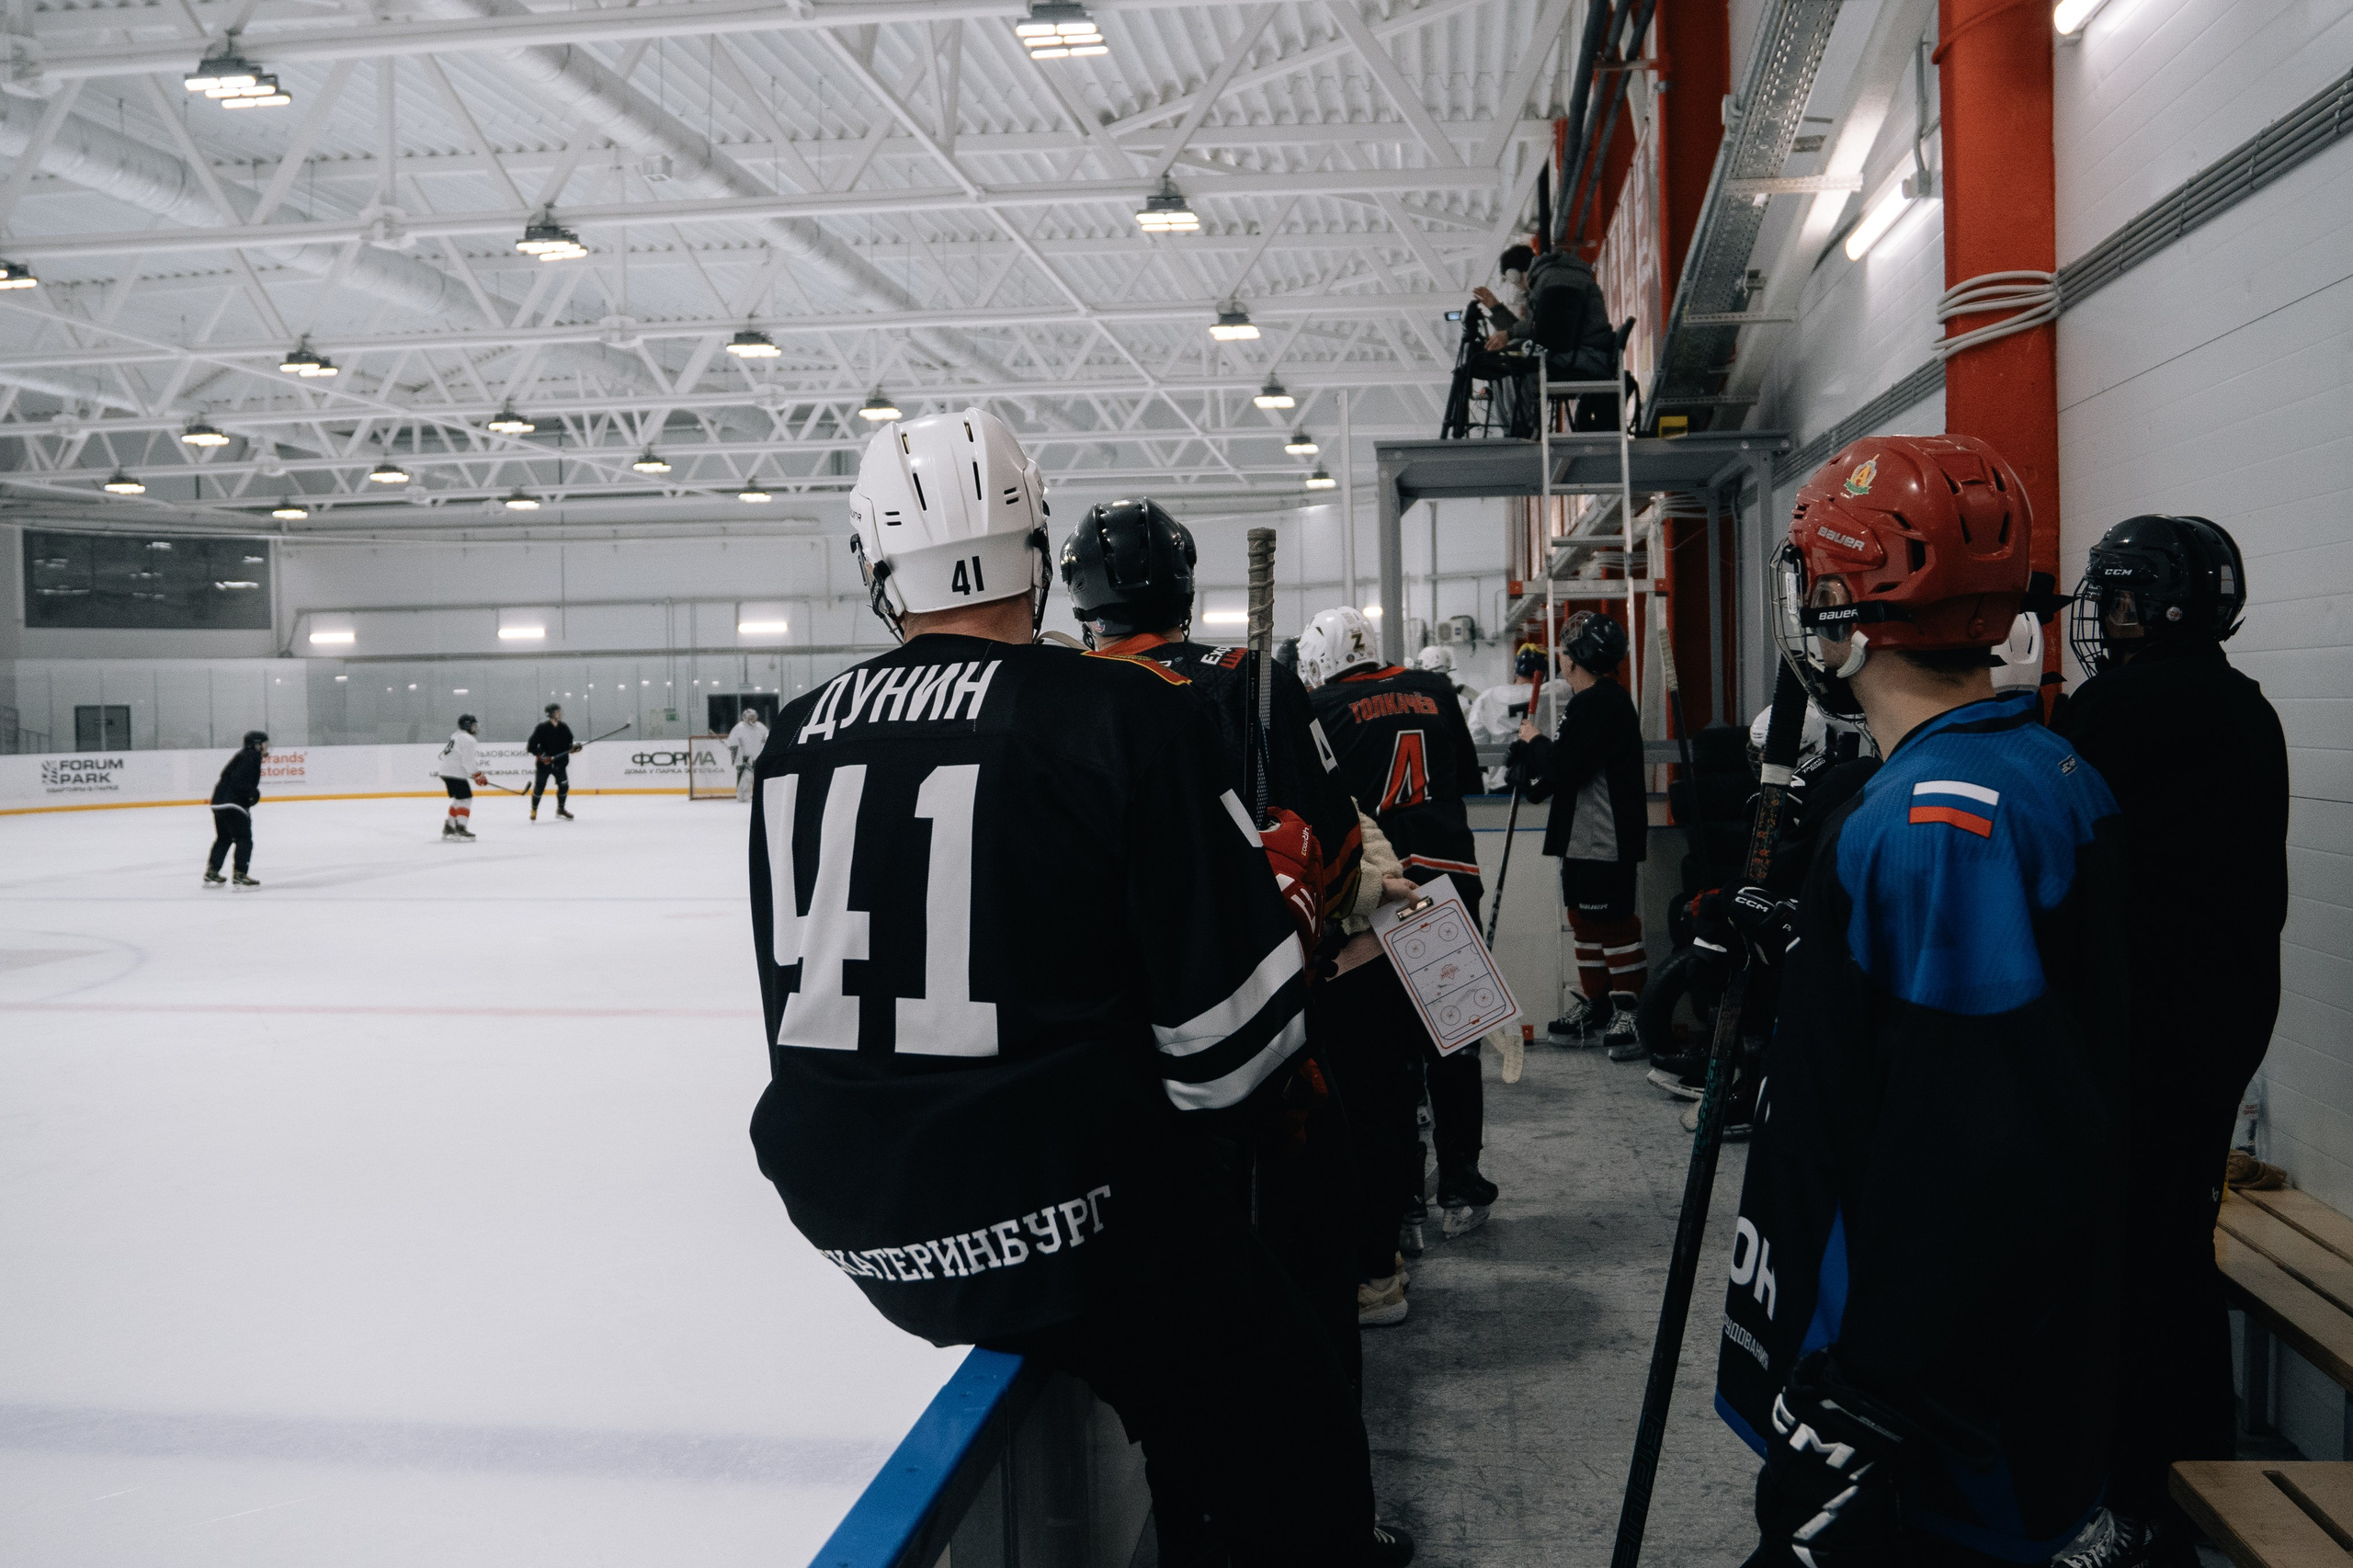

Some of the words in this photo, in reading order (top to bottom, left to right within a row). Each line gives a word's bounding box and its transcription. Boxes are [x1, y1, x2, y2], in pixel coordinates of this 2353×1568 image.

[1818, 526, 1865, 551] BAUER
[951, 555, 984, 596] 41
[797, 660, 1003, 744] ДУНИН
[60, 758, 123, 771] FORUM
[60, 772, 111, 784] PARK
[259, 765, 305, 778] stories
[1376, 729, 1432, 816] 4
[762, 764, 999, 1057] 41
[1734, 896, 1768, 913] CCM
[1771, 1391, 1856, 1470] CM
